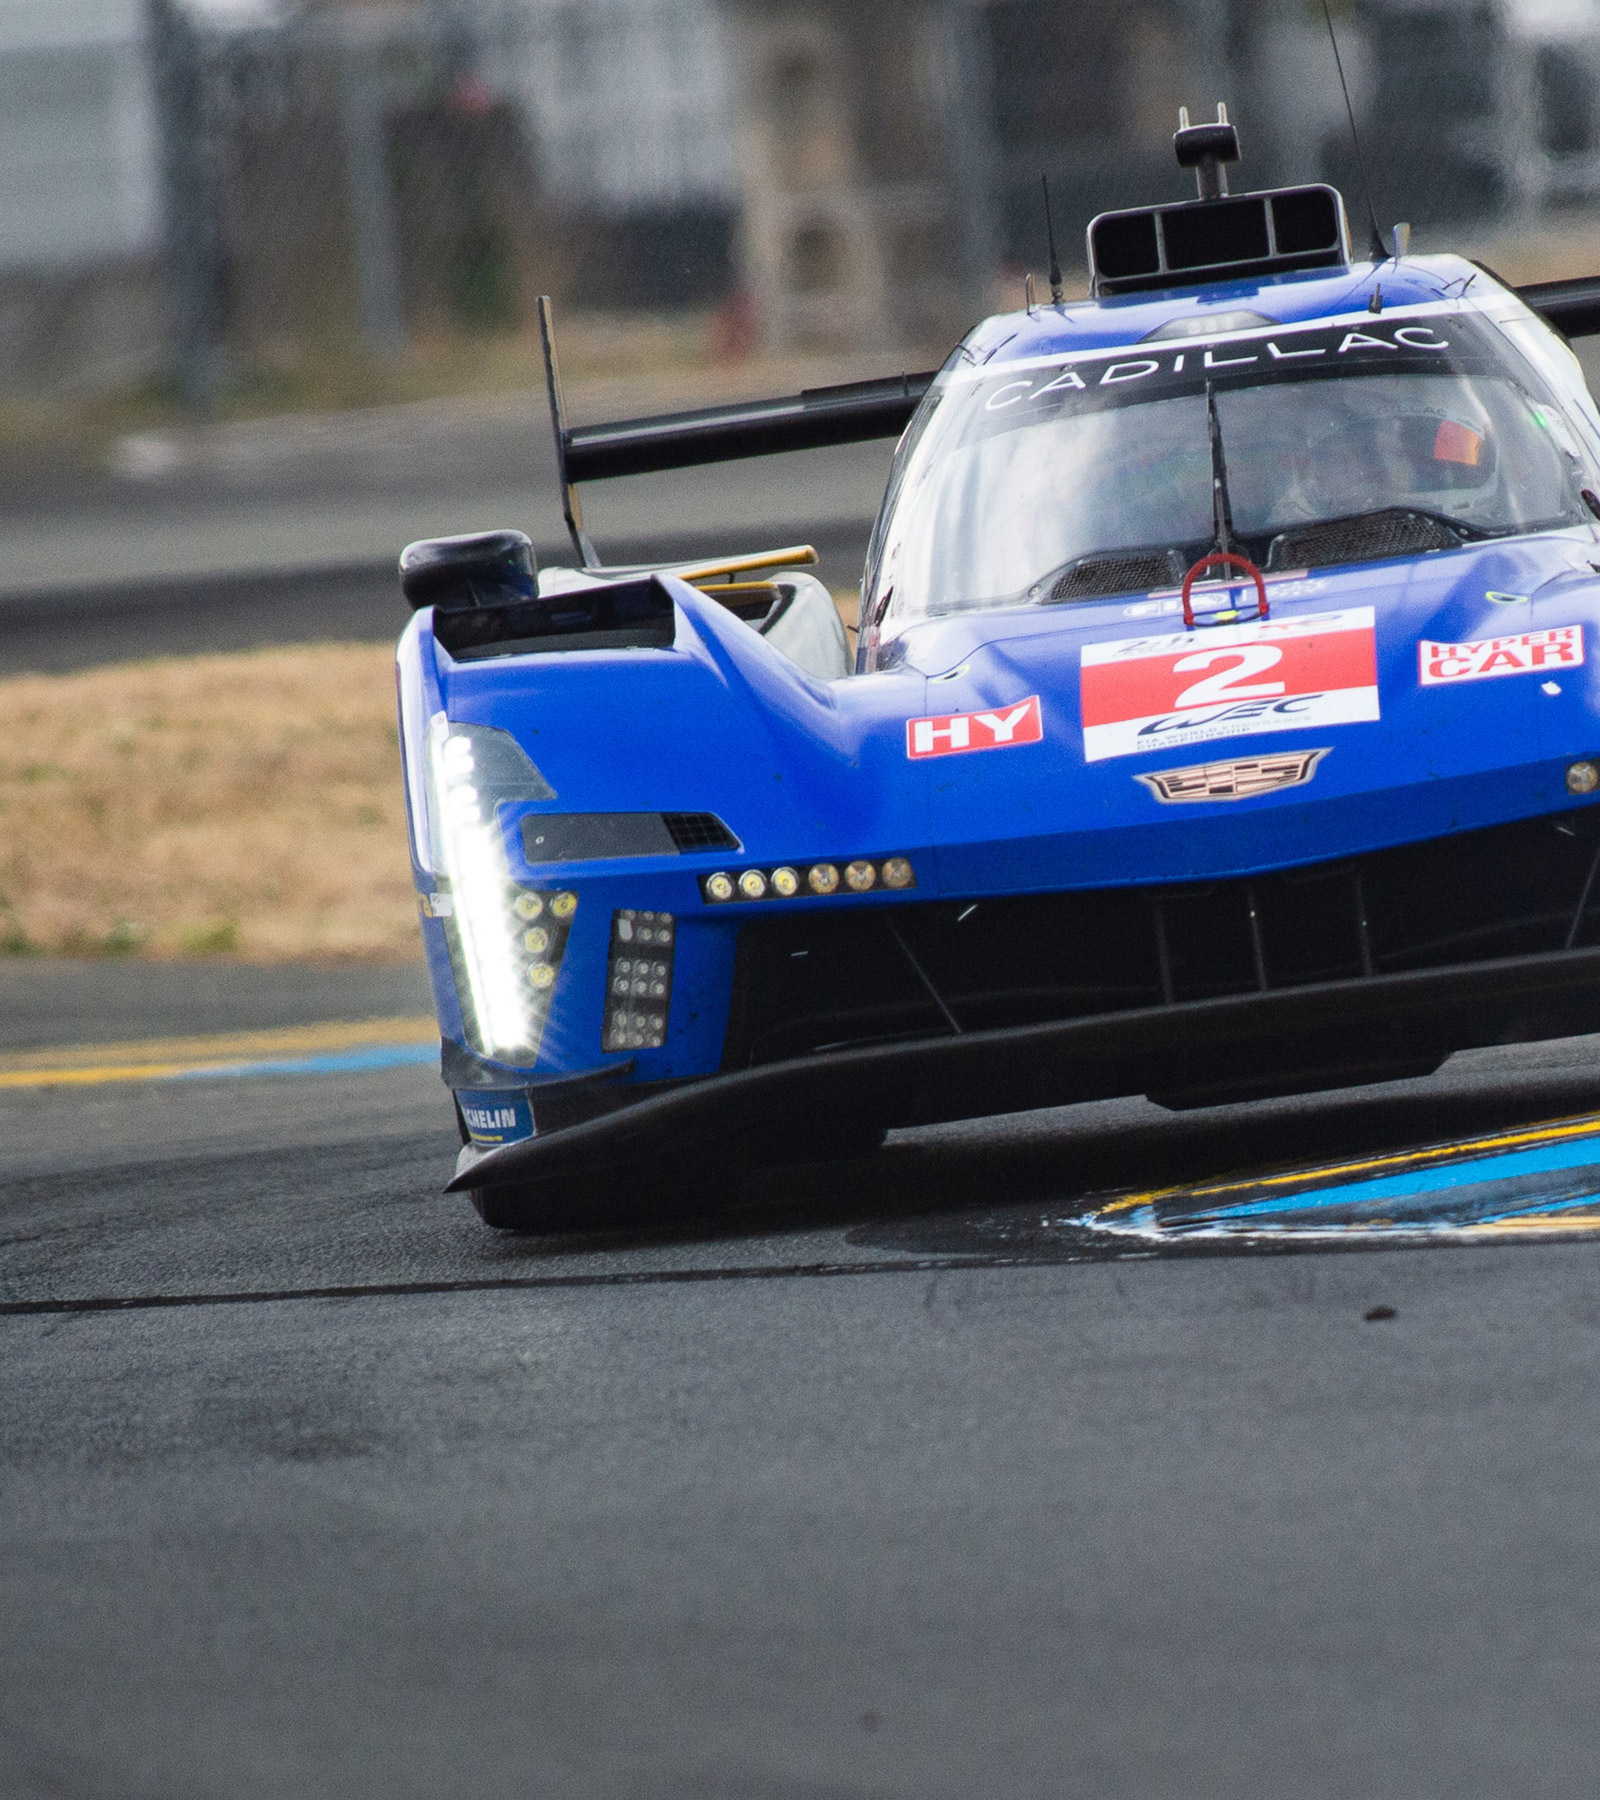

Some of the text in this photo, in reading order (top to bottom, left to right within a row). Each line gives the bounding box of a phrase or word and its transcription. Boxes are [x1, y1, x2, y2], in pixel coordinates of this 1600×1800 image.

[983, 326, 1449, 411] CADILLAC
[1428, 641, 1575, 678] CAR
[1430, 628, 1574, 658] HYPER
[1172, 644, 1286, 709] 2
[914, 702, 1032, 753] HY
[1136, 693, 1324, 737] WEC
